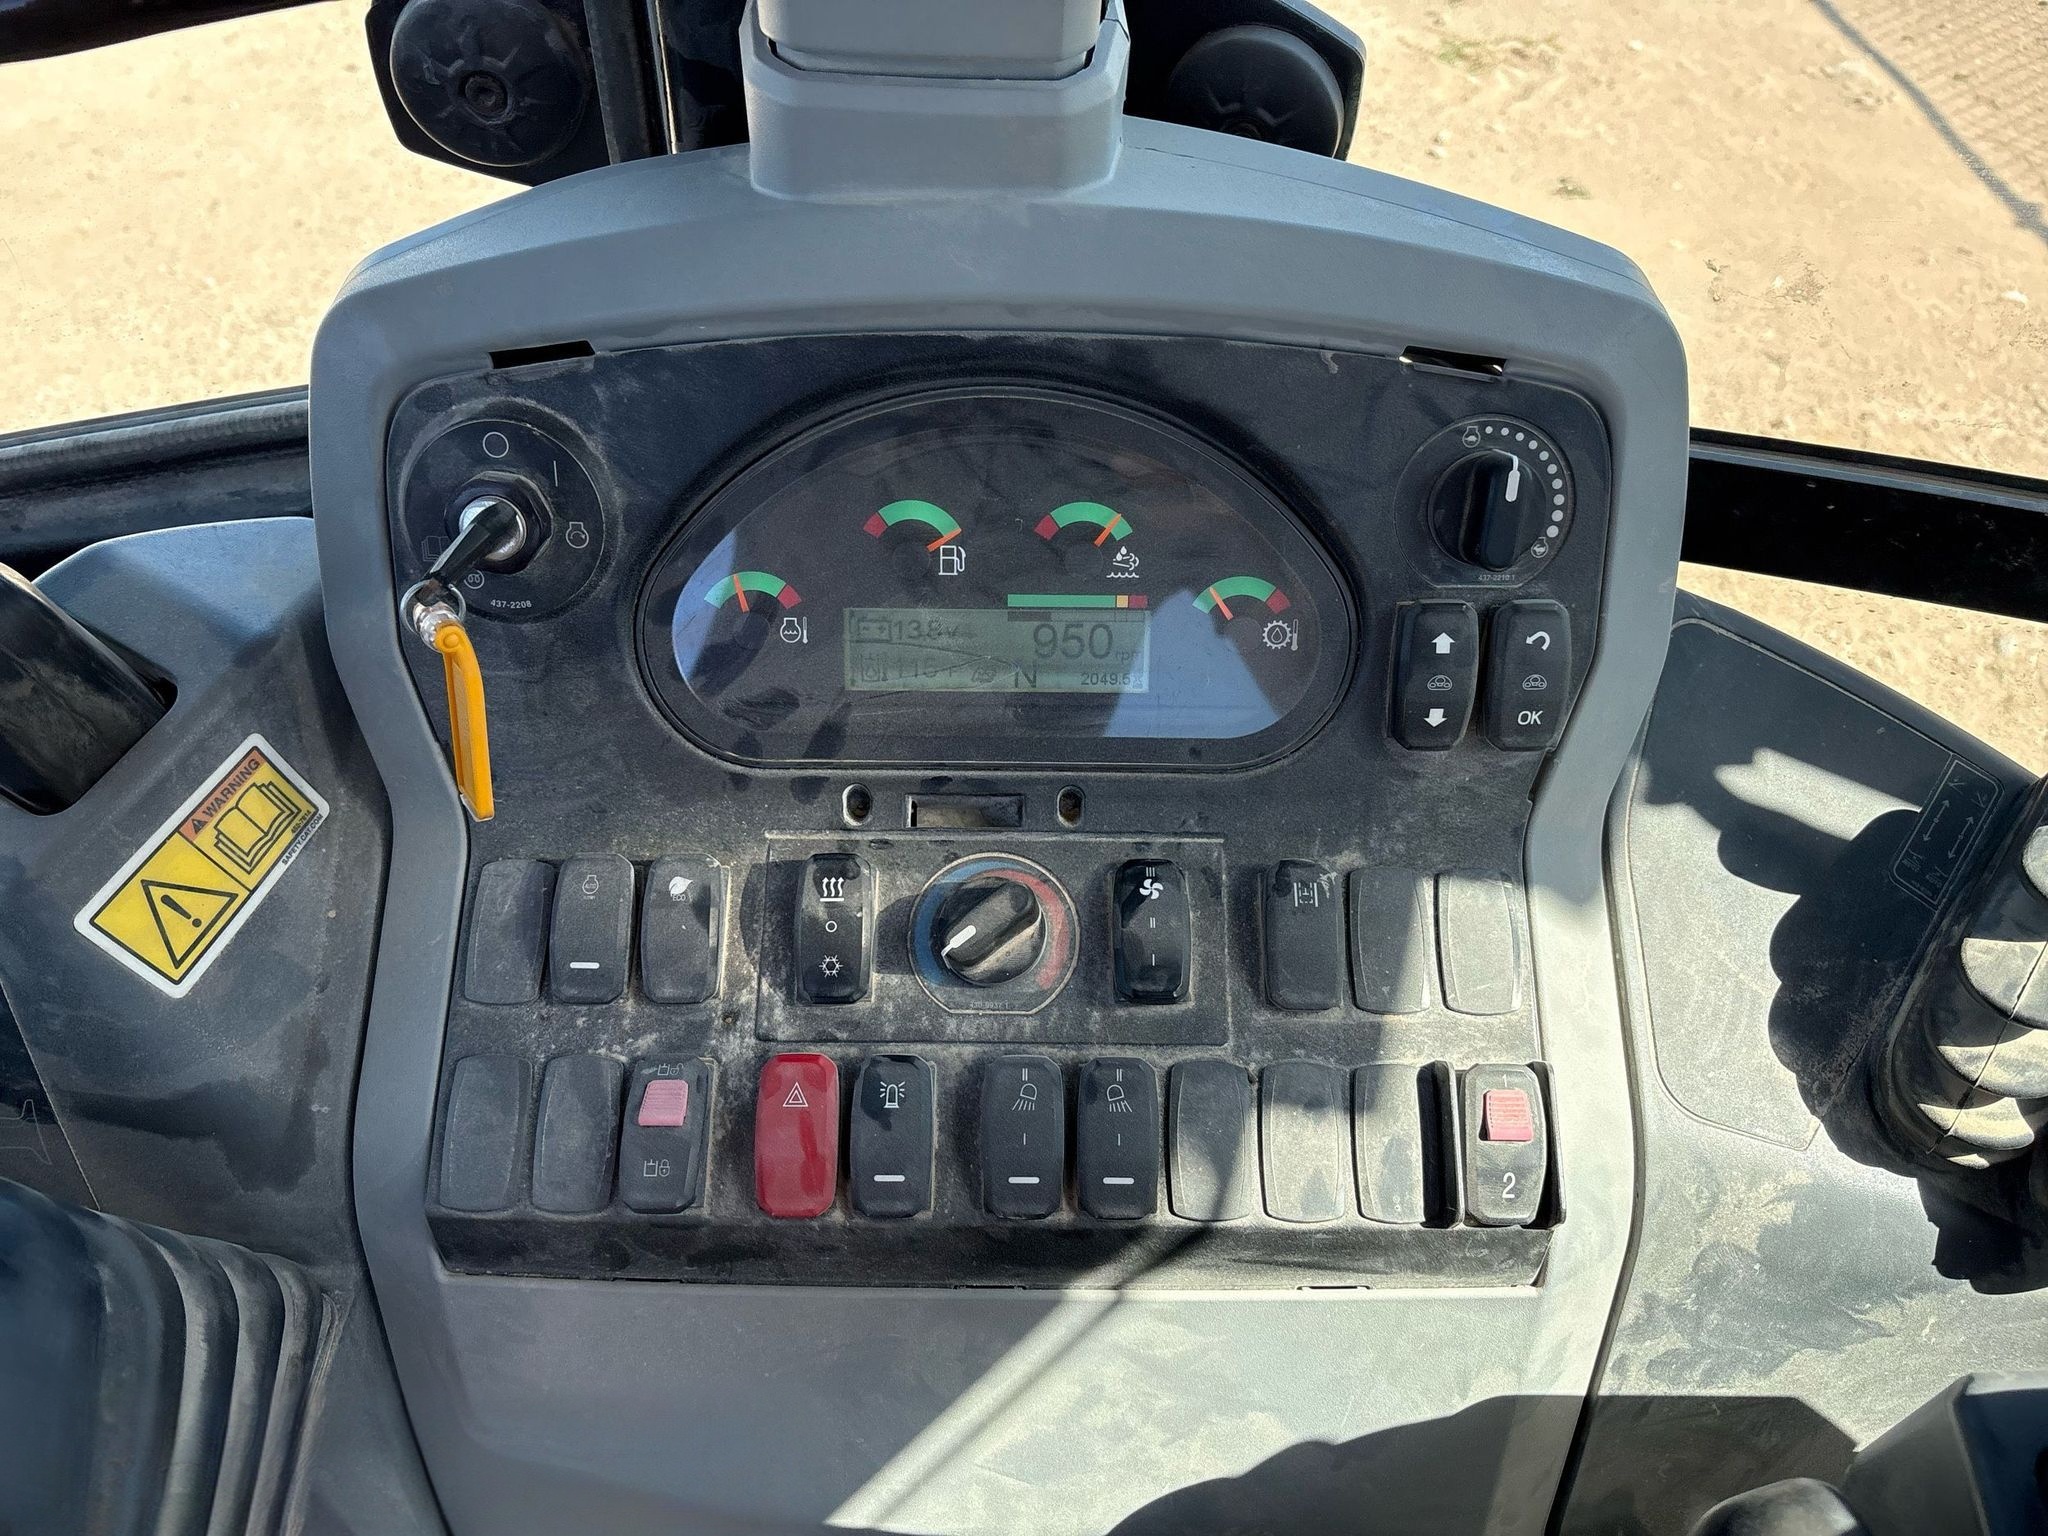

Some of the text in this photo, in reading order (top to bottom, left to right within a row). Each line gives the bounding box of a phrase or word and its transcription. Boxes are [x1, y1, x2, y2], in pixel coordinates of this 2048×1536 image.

[490, 599, 532, 609] 437-2208
[1033, 623, 1114, 660] 950
[1517, 710, 1543, 725] OK
[202, 758, 260, 818] WARNING
[281, 812, 324, 866] SAFETY.CAT.COM
[1502, 1073, 1508, 1088] 1
[1502, 1171, 1516, 1199] 2
